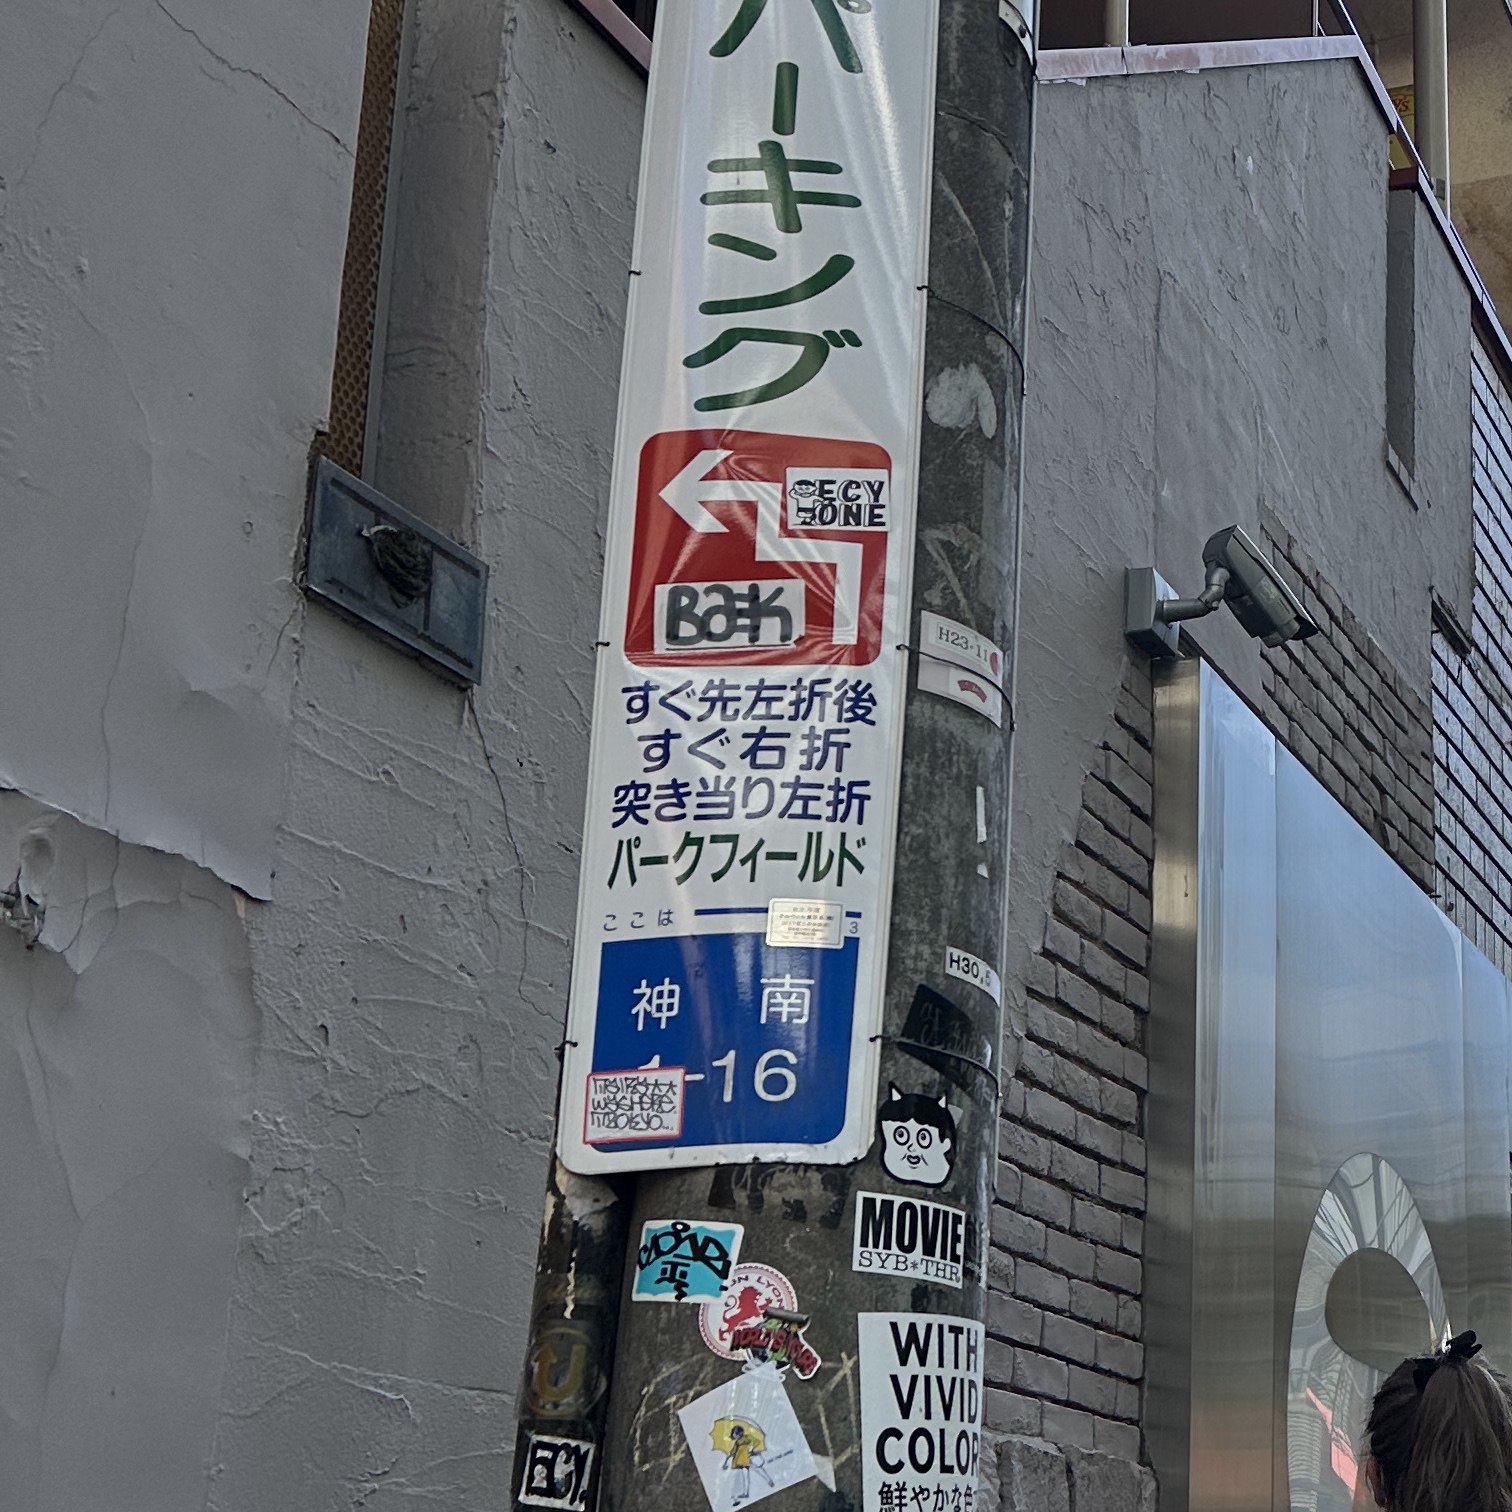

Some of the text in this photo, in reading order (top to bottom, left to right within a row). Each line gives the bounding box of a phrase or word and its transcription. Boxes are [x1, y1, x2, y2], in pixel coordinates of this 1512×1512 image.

[683, 0, 871, 411] パーキング
[621, 677, 877, 725] すぐ先左折後
[637, 725, 851, 773] すぐ右折
[612, 775, 871, 829] 突き当り左折
[607, 830, 867, 888] パークフィールド
[603, 909, 674, 931] ここは
[631, 974, 815, 1031] 神南
[637, 1048, 799, 1103] -16
[859, 1196, 963, 1265] MOVIE
[889, 1321, 978, 1373] WITH
[889, 1374, 978, 1424] VIVID
[876, 1427, 979, 1477] COLOR
